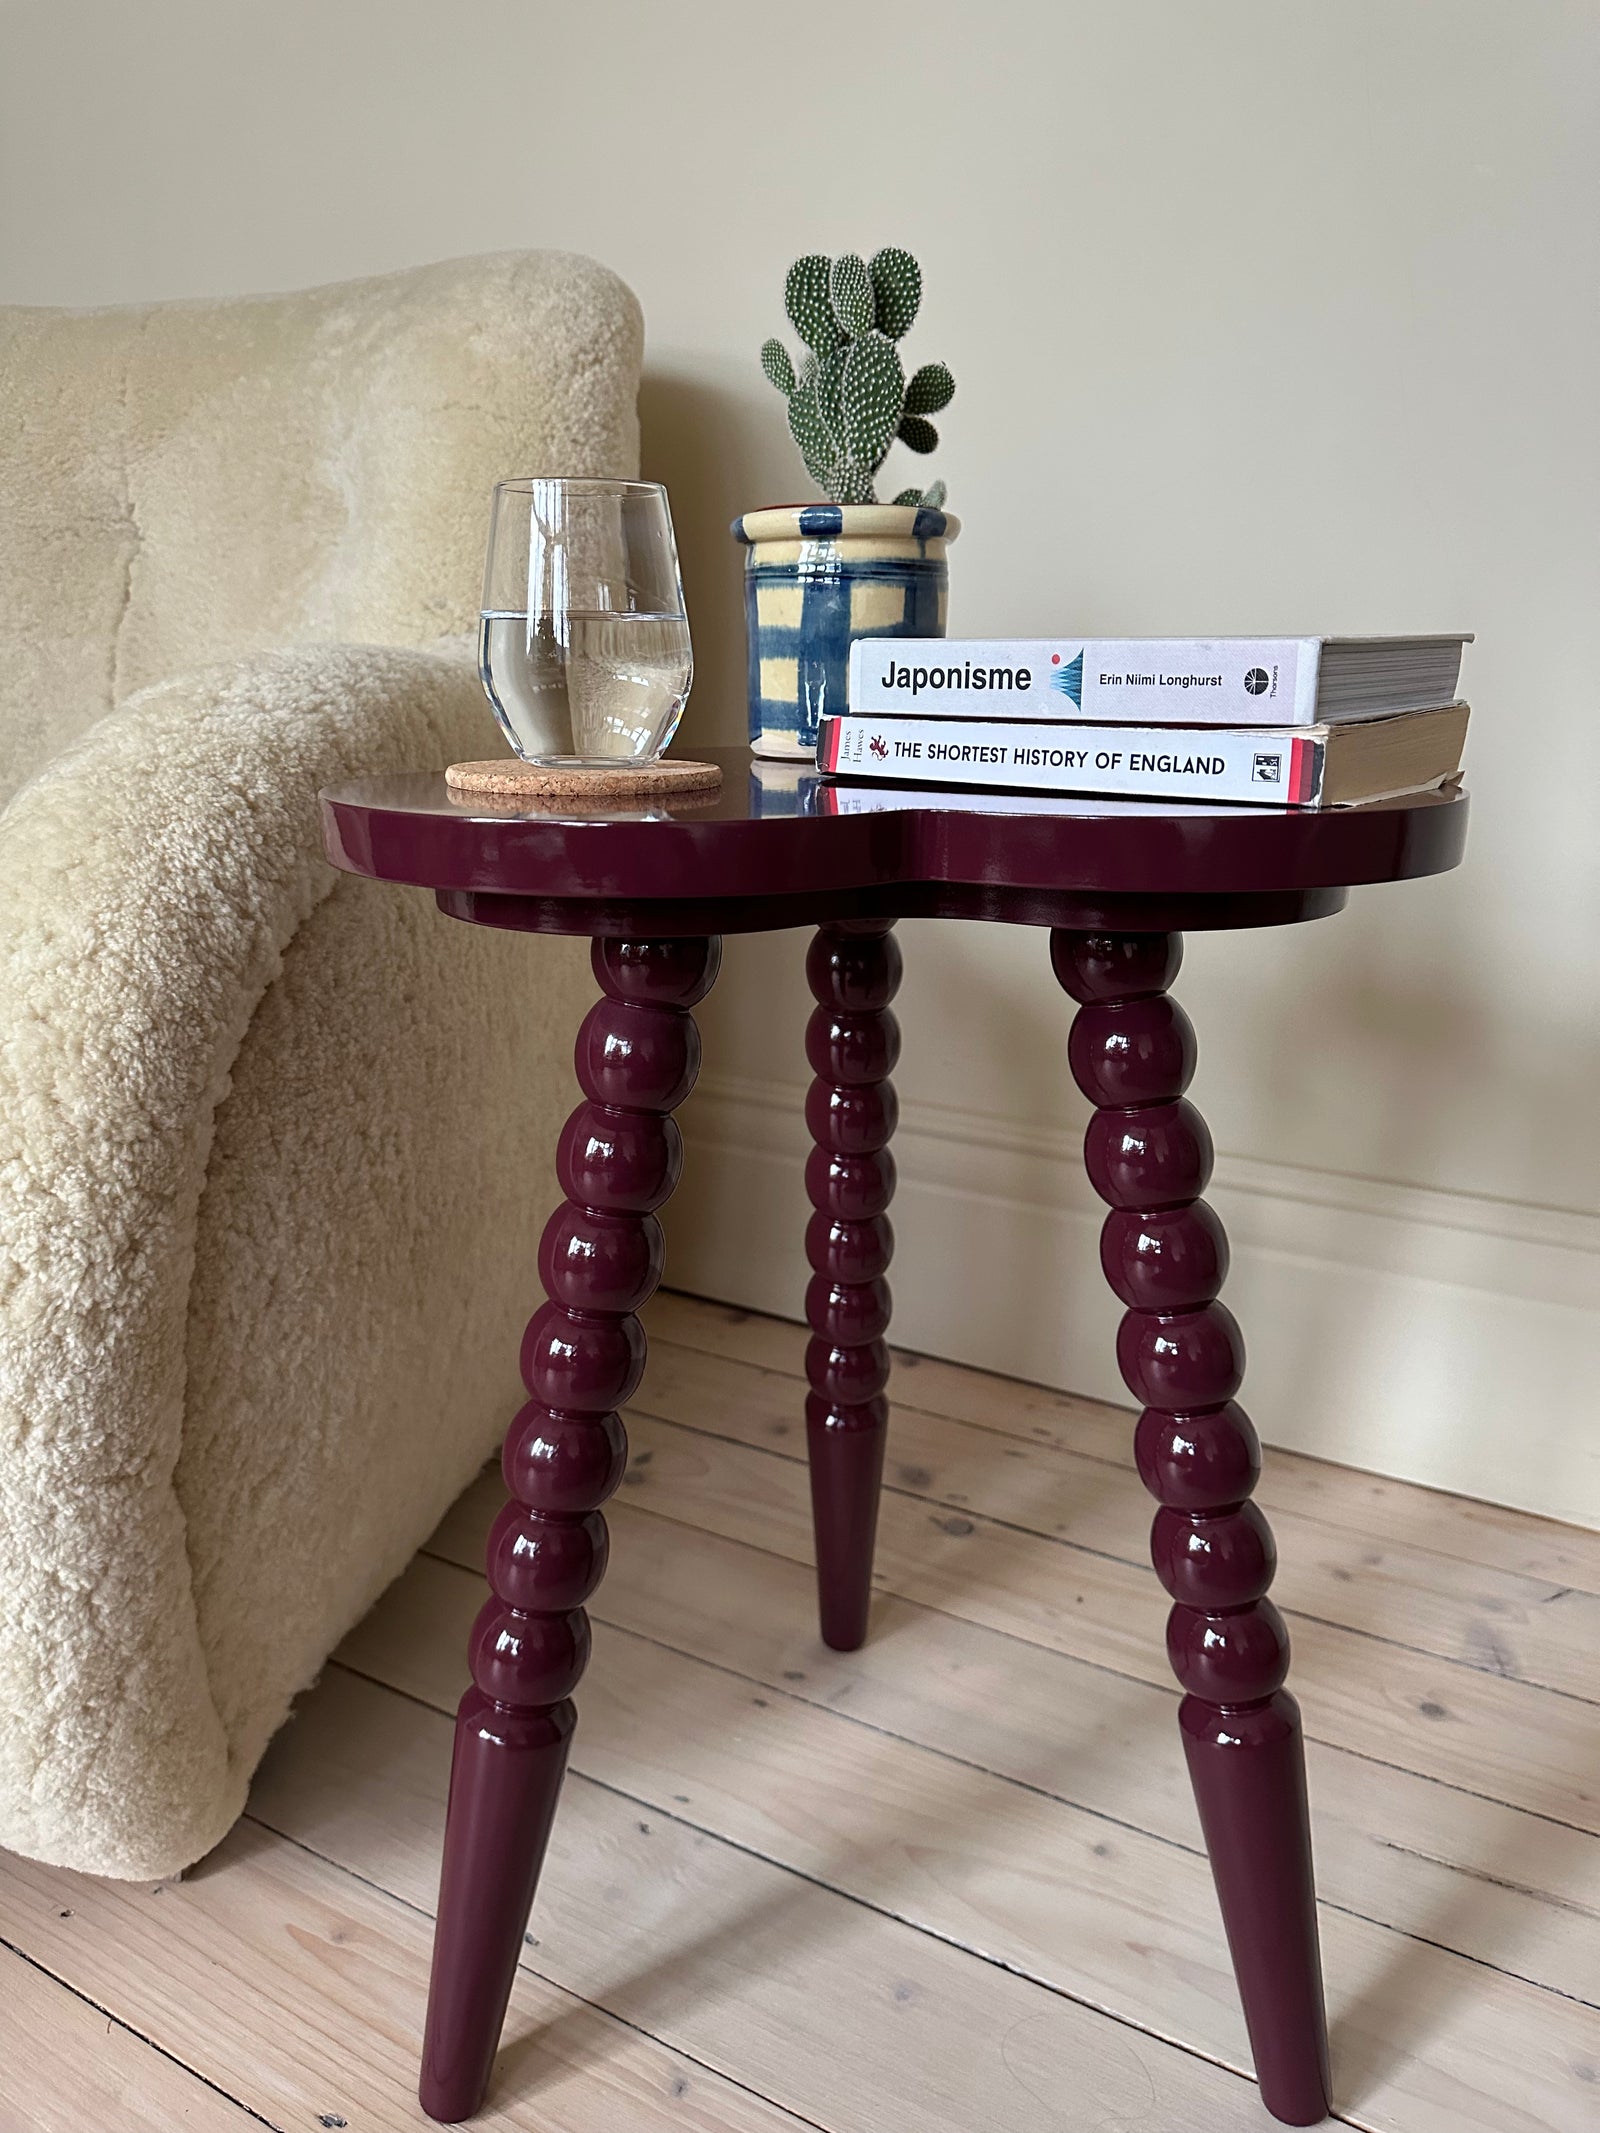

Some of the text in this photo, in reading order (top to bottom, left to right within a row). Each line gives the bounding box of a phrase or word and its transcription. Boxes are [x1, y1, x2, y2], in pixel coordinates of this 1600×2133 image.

[881, 660, 1032, 696] Japonisme
[1099, 673, 1223, 689] Erin Niimi Longhurst
[1269, 665, 1279, 699] Thorsons
[840, 730, 852, 761] James
[853, 729, 864, 763] Hawes
[894, 741, 1226, 775] THE SHORTEST HISTORY OF ENGLAND
